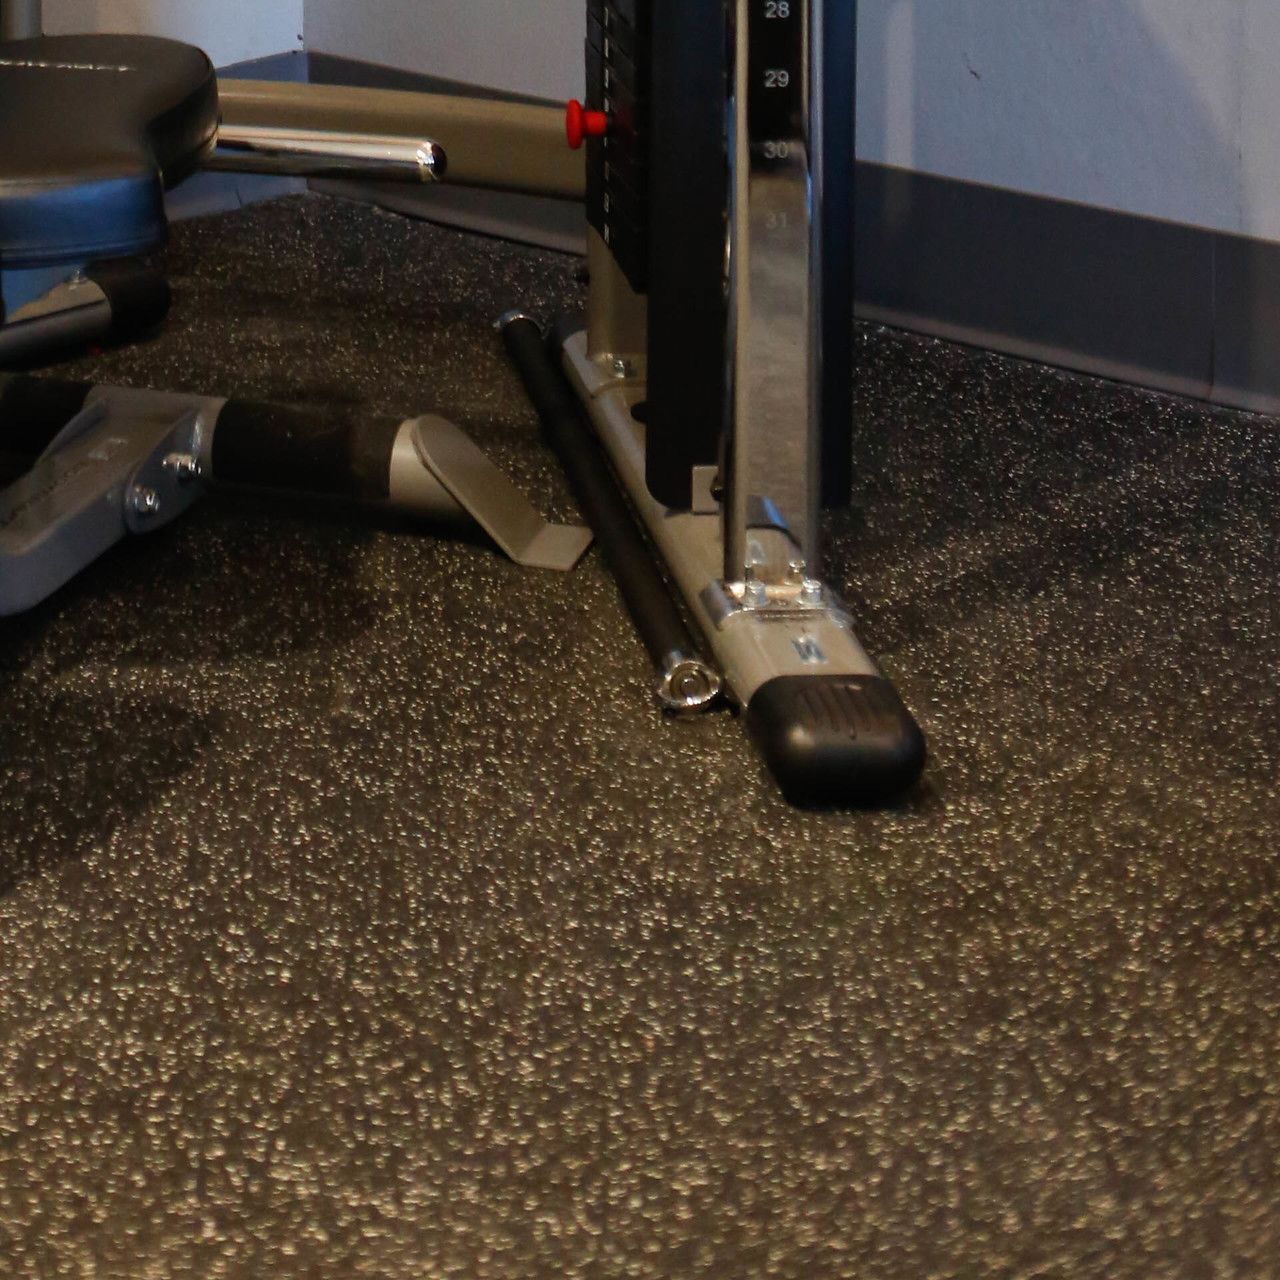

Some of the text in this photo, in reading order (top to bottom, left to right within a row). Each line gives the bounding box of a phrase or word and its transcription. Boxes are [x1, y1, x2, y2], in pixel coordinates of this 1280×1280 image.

[764, 1, 790, 19] 28
[764, 70, 789, 88] 29
[764, 141, 789, 159] 30
